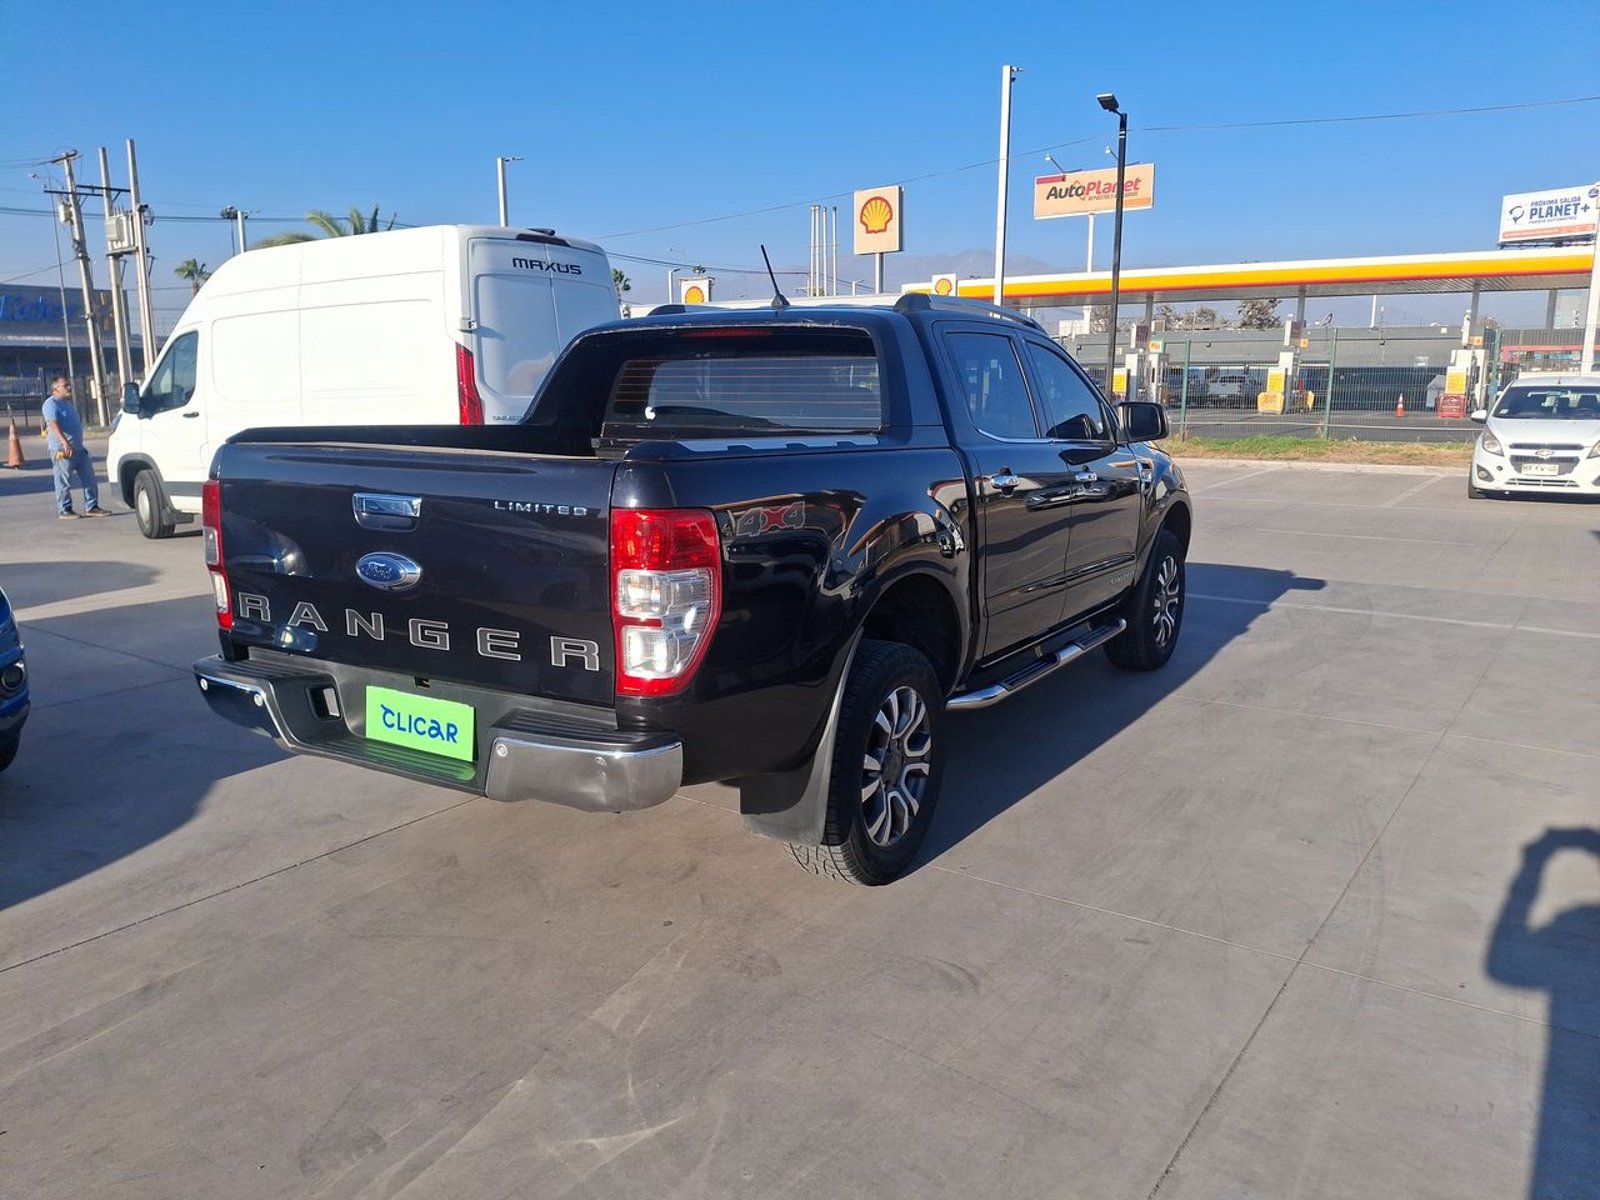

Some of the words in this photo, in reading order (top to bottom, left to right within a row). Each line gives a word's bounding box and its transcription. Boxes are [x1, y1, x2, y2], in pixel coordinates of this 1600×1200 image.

[512, 257, 582, 275] MAXUS
[494, 500, 588, 517] LIMITED
[238, 592, 600, 671] RANGER
